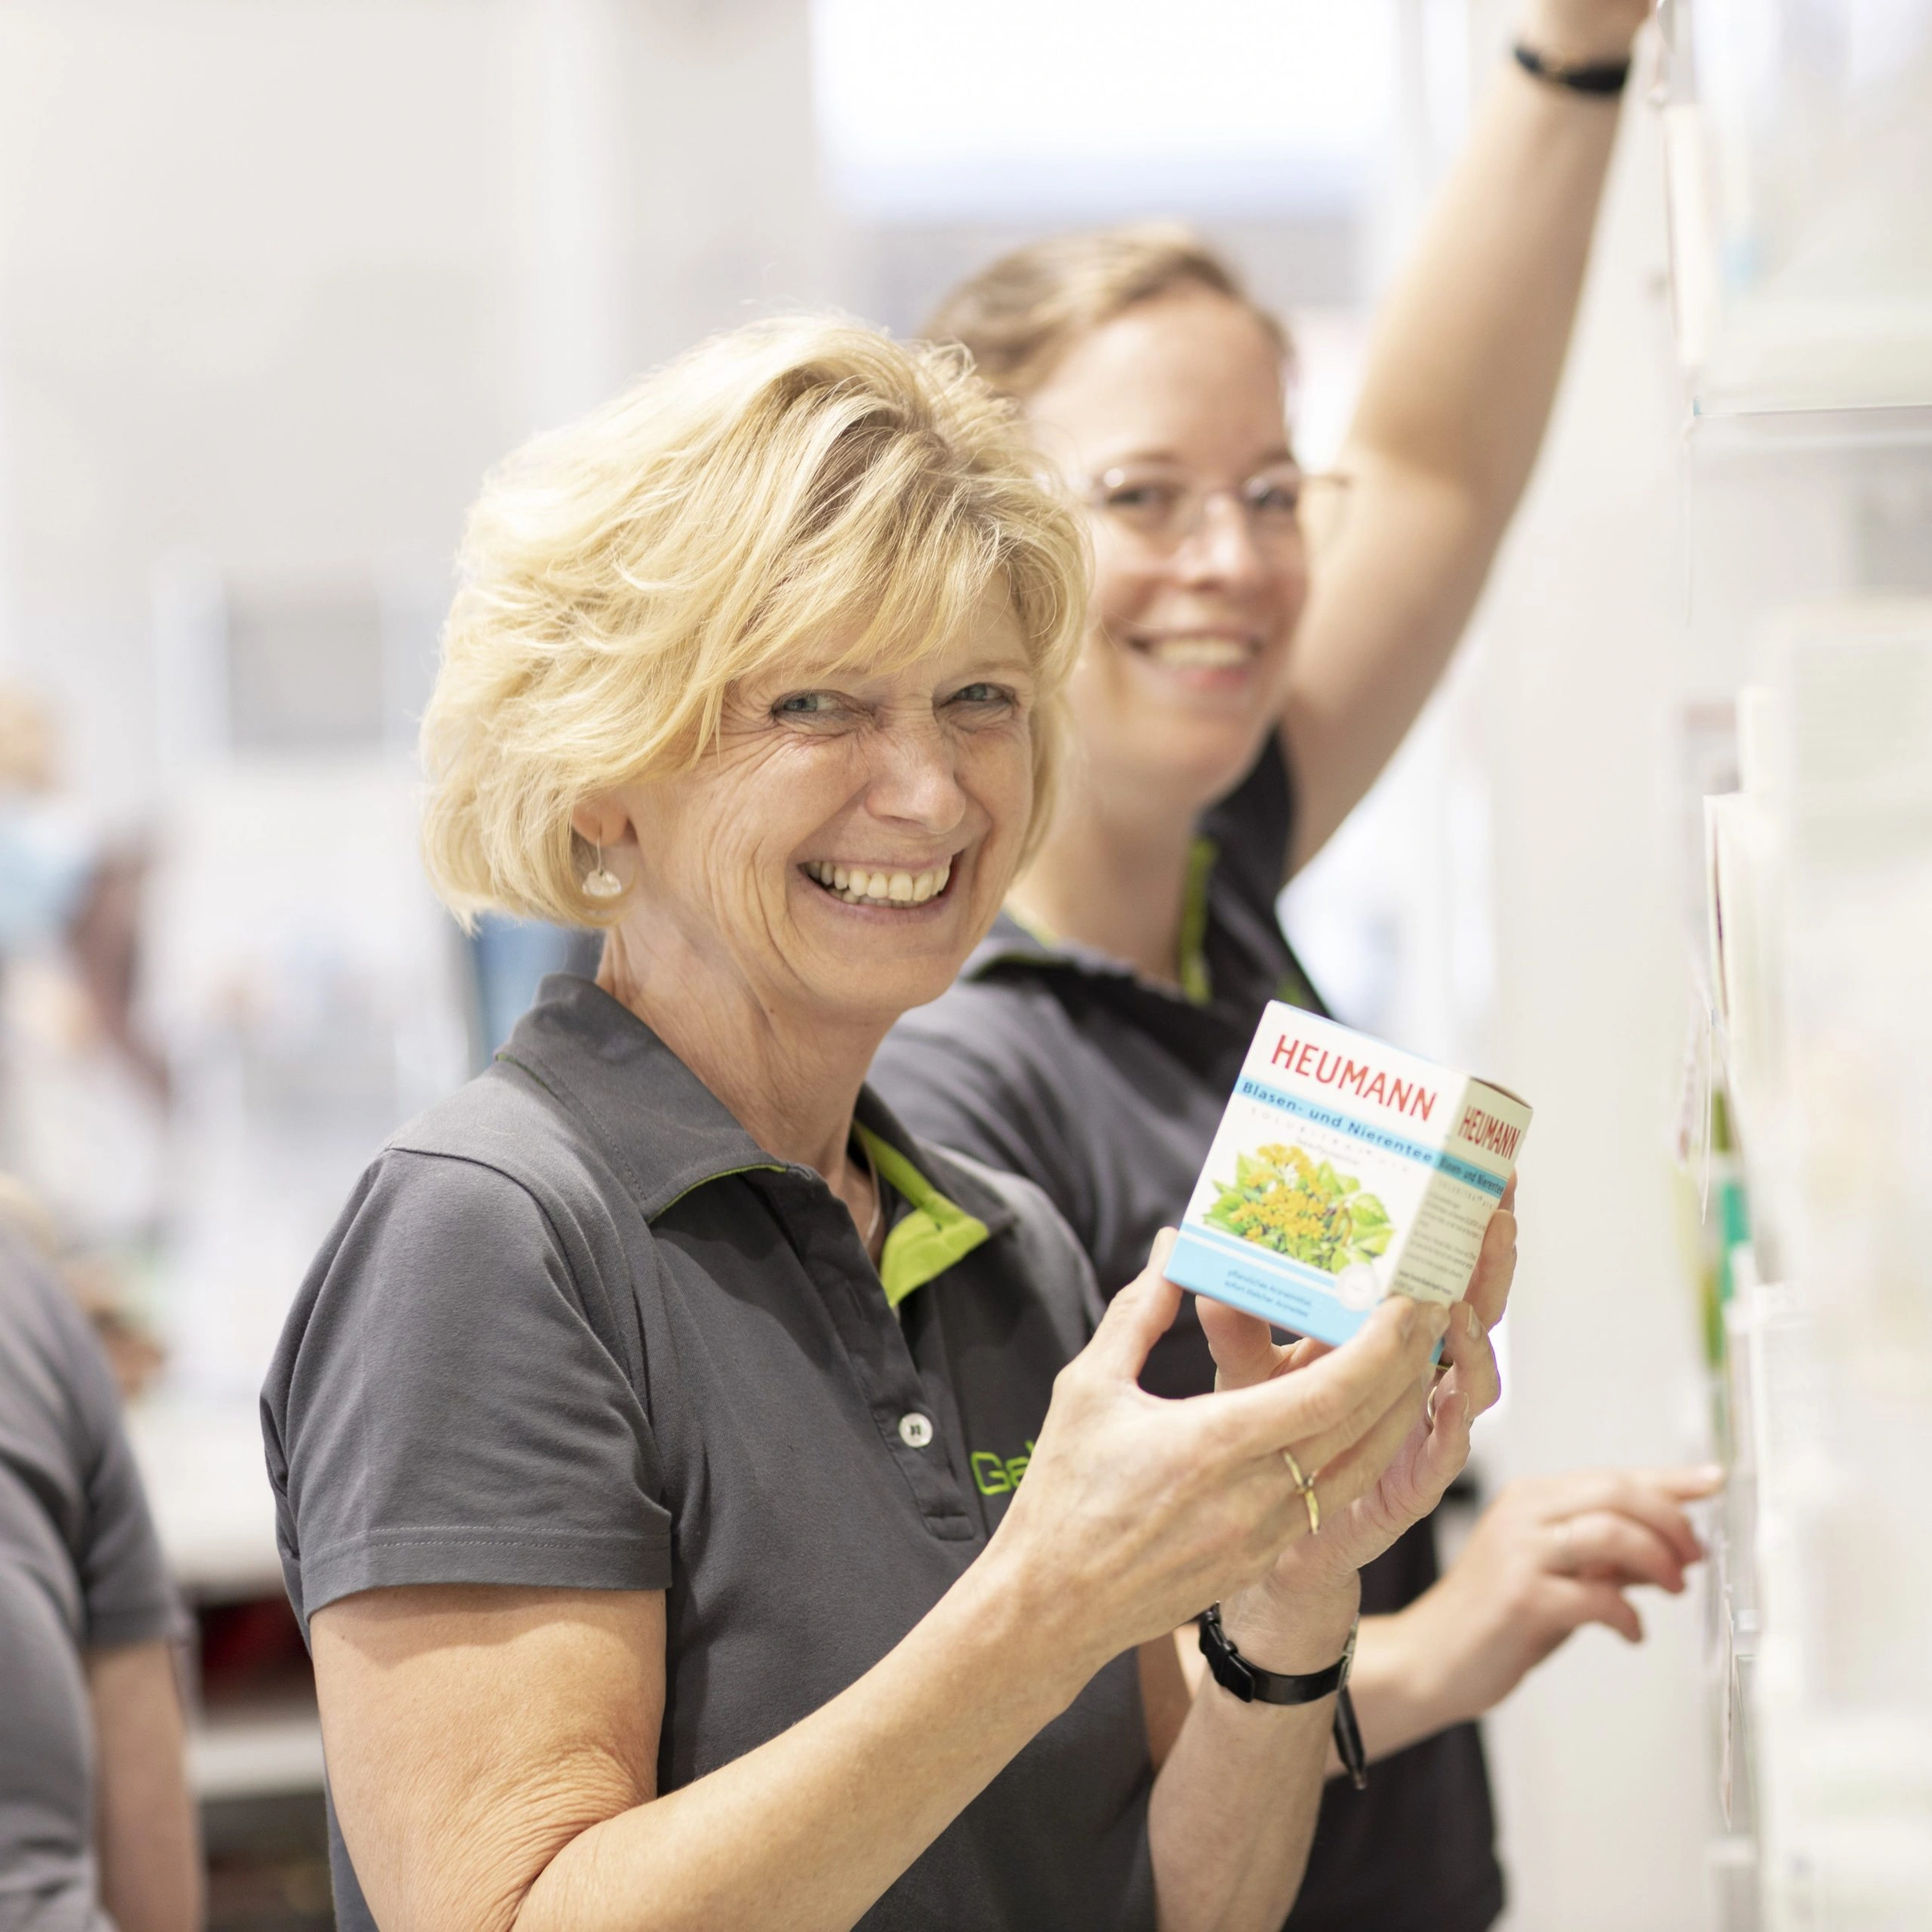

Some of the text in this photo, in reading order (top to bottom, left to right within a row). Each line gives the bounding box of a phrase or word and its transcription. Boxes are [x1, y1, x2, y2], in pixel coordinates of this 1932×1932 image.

[1271, 1034, 1438, 1121] HEUMANN
[1242, 1081, 1304, 1112] Blasen-
[1309, 1109, 1344, 1128] und
[1347, 1121, 1432, 1161] Nierentee
[1457, 1104, 1521, 1160] HEUMANN
[971, 1439, 1036, 1496] Ge
